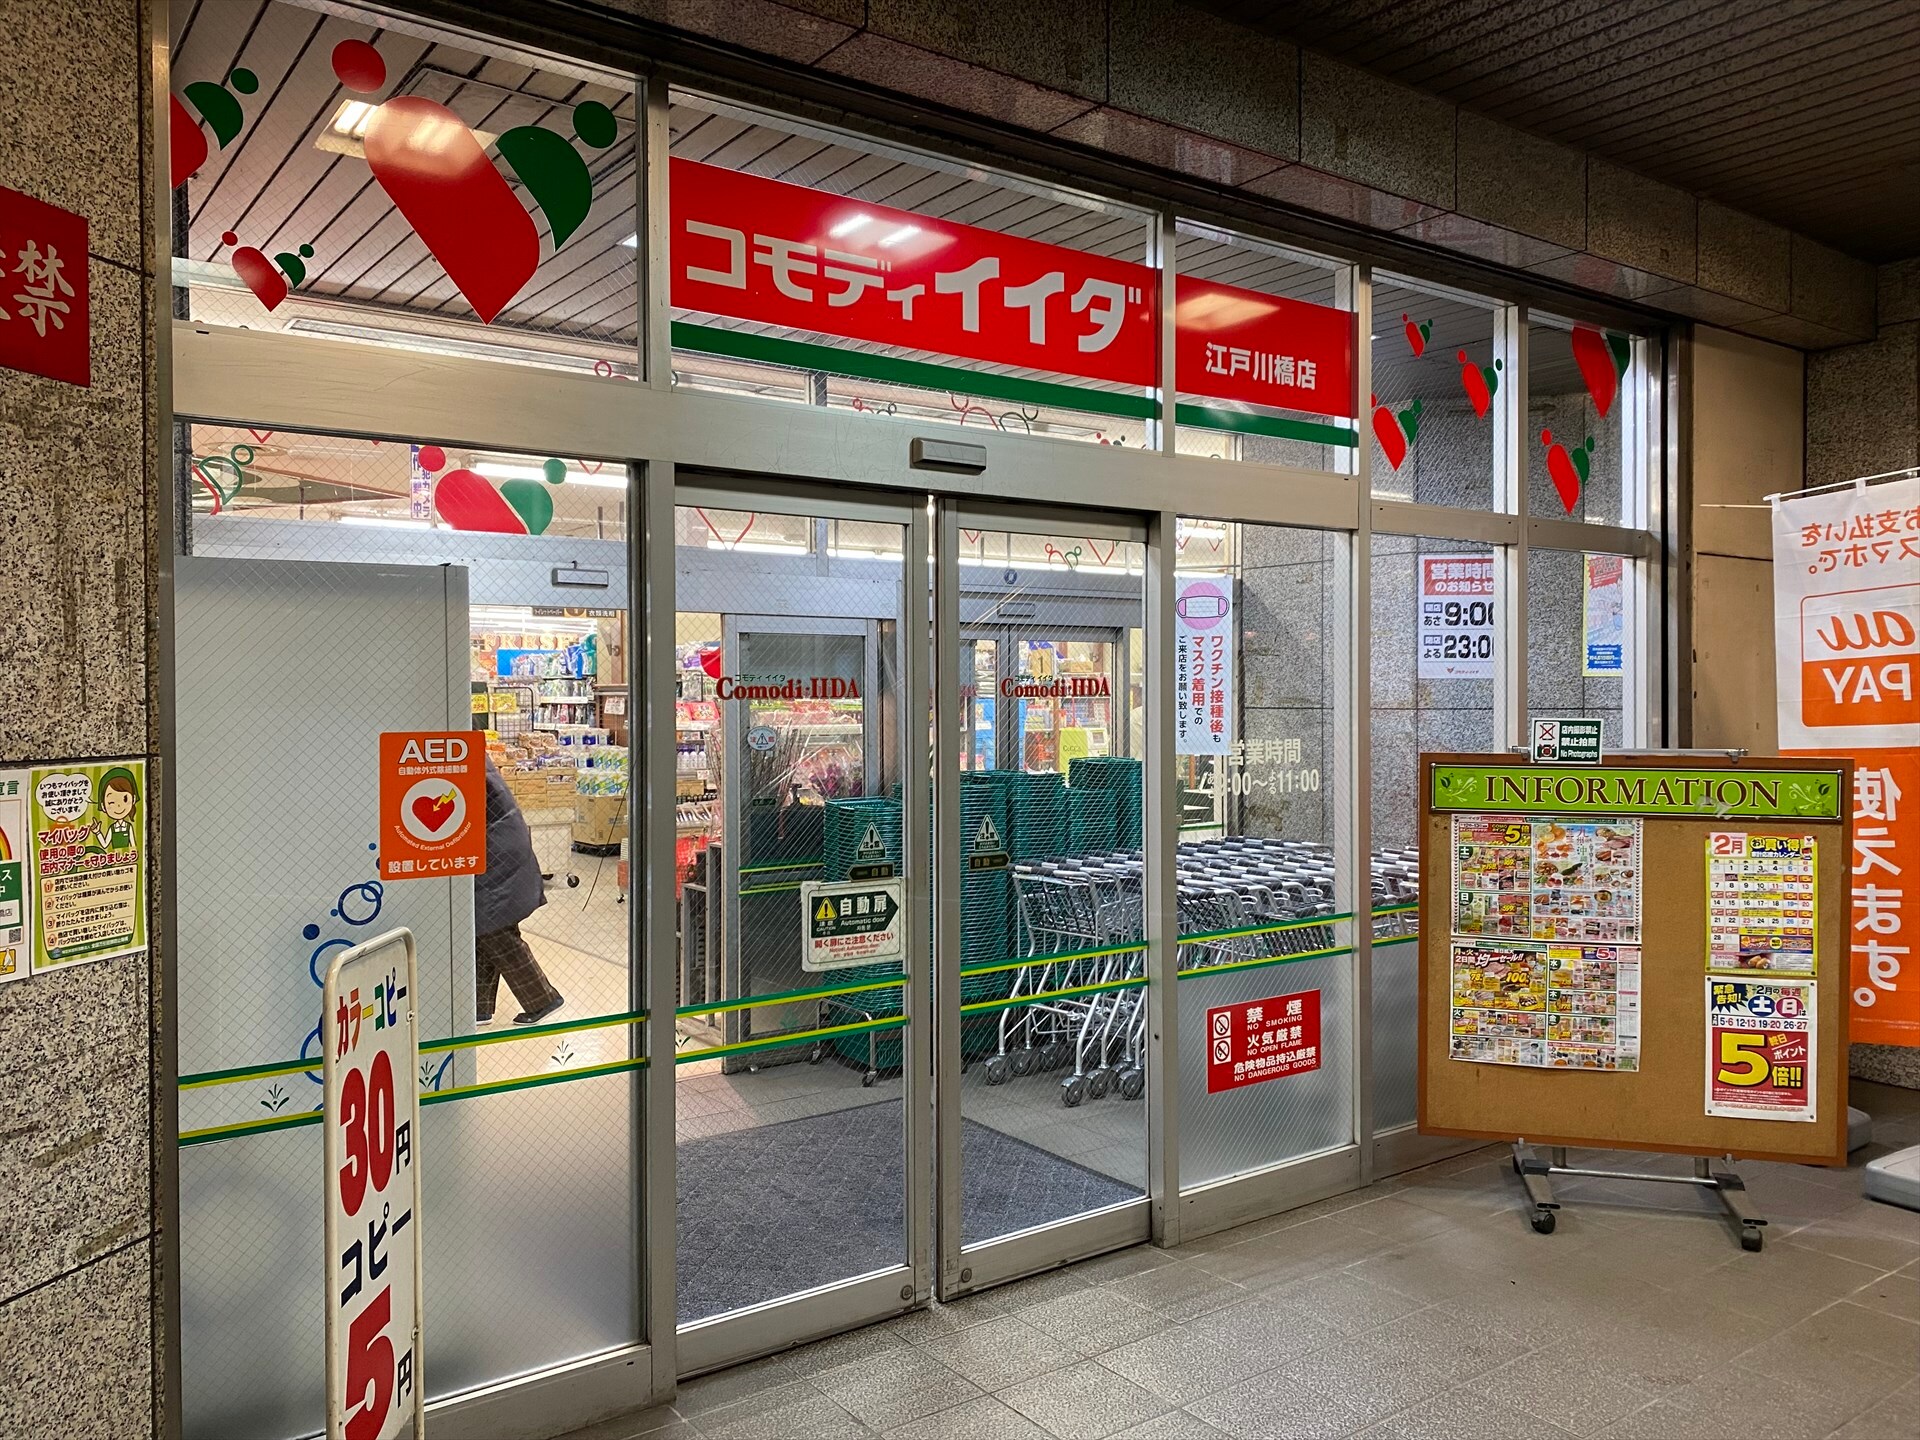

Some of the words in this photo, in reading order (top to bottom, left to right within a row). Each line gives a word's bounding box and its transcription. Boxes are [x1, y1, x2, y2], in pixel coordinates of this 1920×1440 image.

[0, 239, 75, 337] 禁
[685, 218, 1142, 354] コモディイイダ
[1204, 341, 1317, 391] 江戸川橋店
[1444, 635, 1494, 659] 23:0
[1191, 635, 1206, 725] マスク着用での
[1210, 635, 1224, 743] ワクチン接種後も
[398, 738, 469, 764] AED
[1228, 738, 1301, 766] 営業時間
[1560, 749, 1568, 758] No
[1484, 775, 1782, 810] INFORMATION
[38, 825, 91, 844] マイバッグ
[394, 824, 420, 850] Automated
[420, 844, 445, 852] External
[1713, 834, 1744, 855] 2月
[388, 855, 480, 874] 設置しています
[840, 895, 888, 916] 自動扉
[335, 966, 408, 1058] カラーコピー
[1752, 996, 1773, 1013] 土
[1781, 998, 1798, 1015] 日
[1247, 1023, 1259, 1031] NO
[1265, 1014, 1303, 1028] SMOKING
[1247, 1025, 1302, 1049] 火気厳禁
[1247, 1048, 1258, 1056] NO
[1260, 1044, 1279, 1053] OPEN
[1281, 1039, 1303, 1050] FLAME
[1717, 1031, 1770, 1087] 5
[1773, 1045, 1807, 1060] ポイント
[1234, 1074, 1245, 1082] NO
[1247, 1064, 1290, 1079] DANGEROUS
[1292, 1057, 1317, 1069] GOODS
[340, 1201, 412, 1308] コピー
